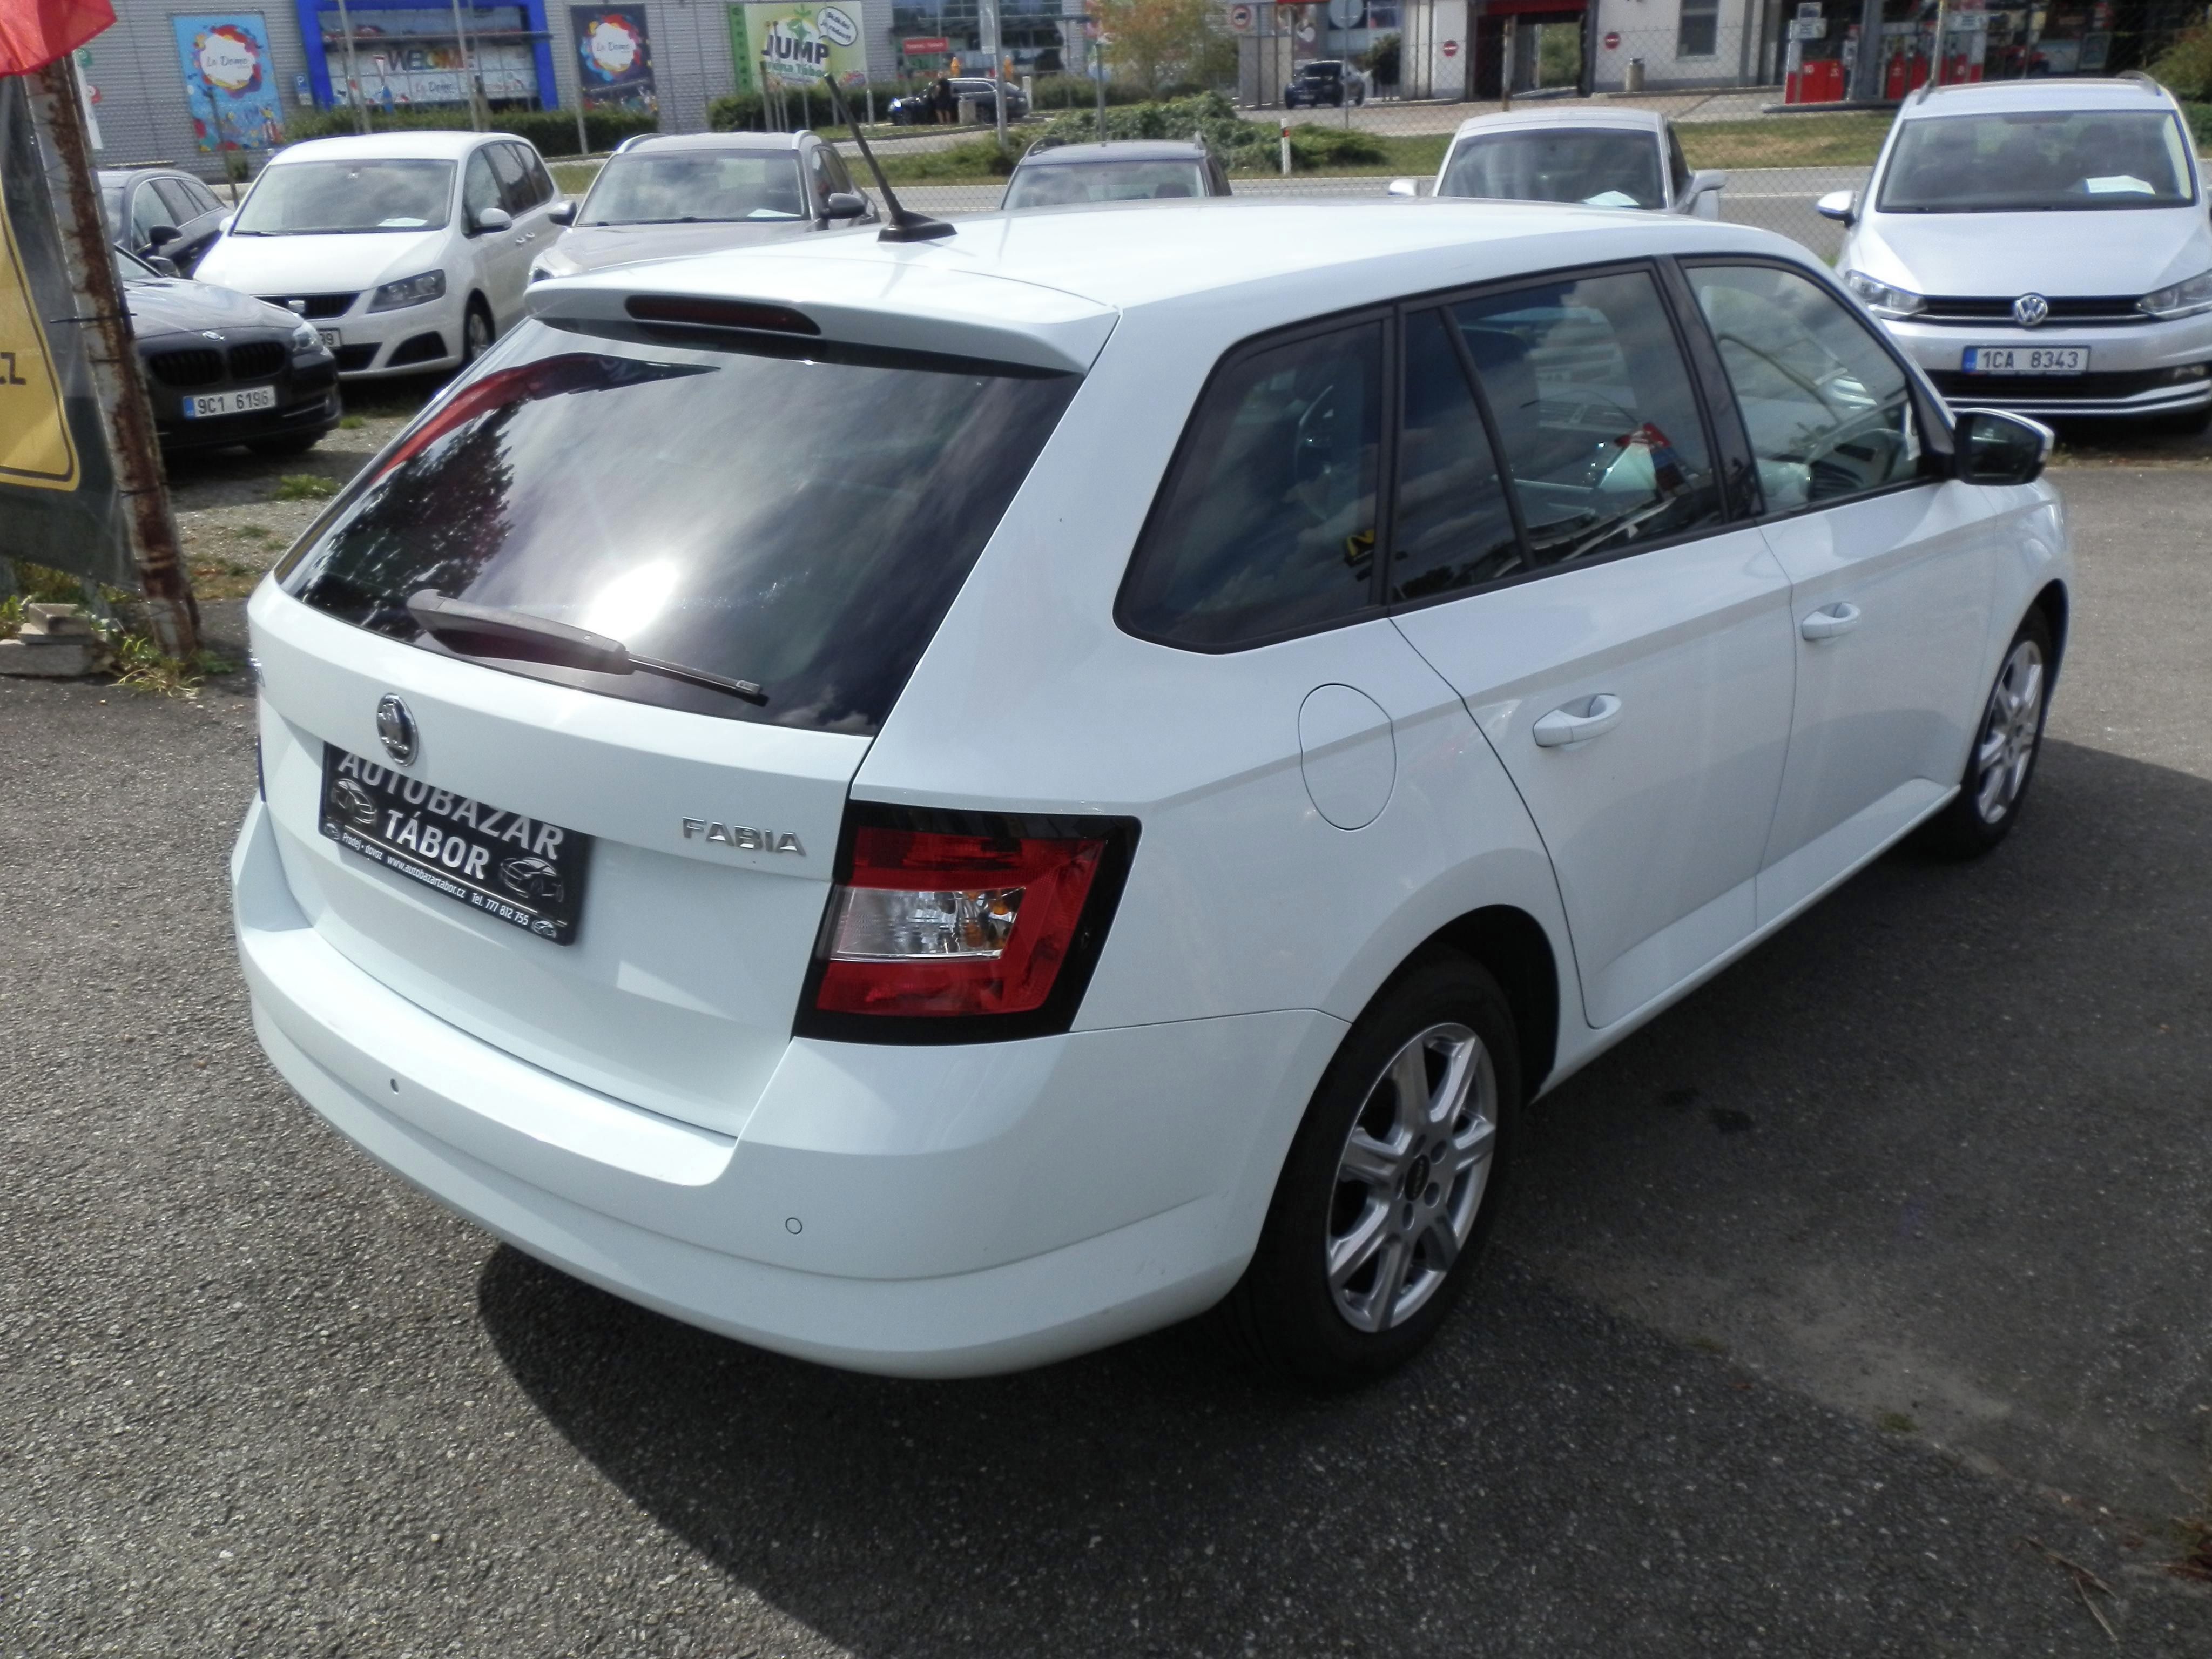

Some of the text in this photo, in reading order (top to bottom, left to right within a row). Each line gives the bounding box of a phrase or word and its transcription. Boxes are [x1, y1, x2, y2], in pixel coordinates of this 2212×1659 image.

[761, 34, 829, 64] JUMP
[1982, 351, 2014, 368] 1CA
[2031, 351, 2079, 368] 8343
[198, 390, 269, 414] 9C1 6196
[386, 808, 490, 880] TÁBOR
[682, 815, 807, 857] FABIA
[342, 832, 529, 926] Prodej dovoz www.autobazartabor.cz Tel. 777 812 755
